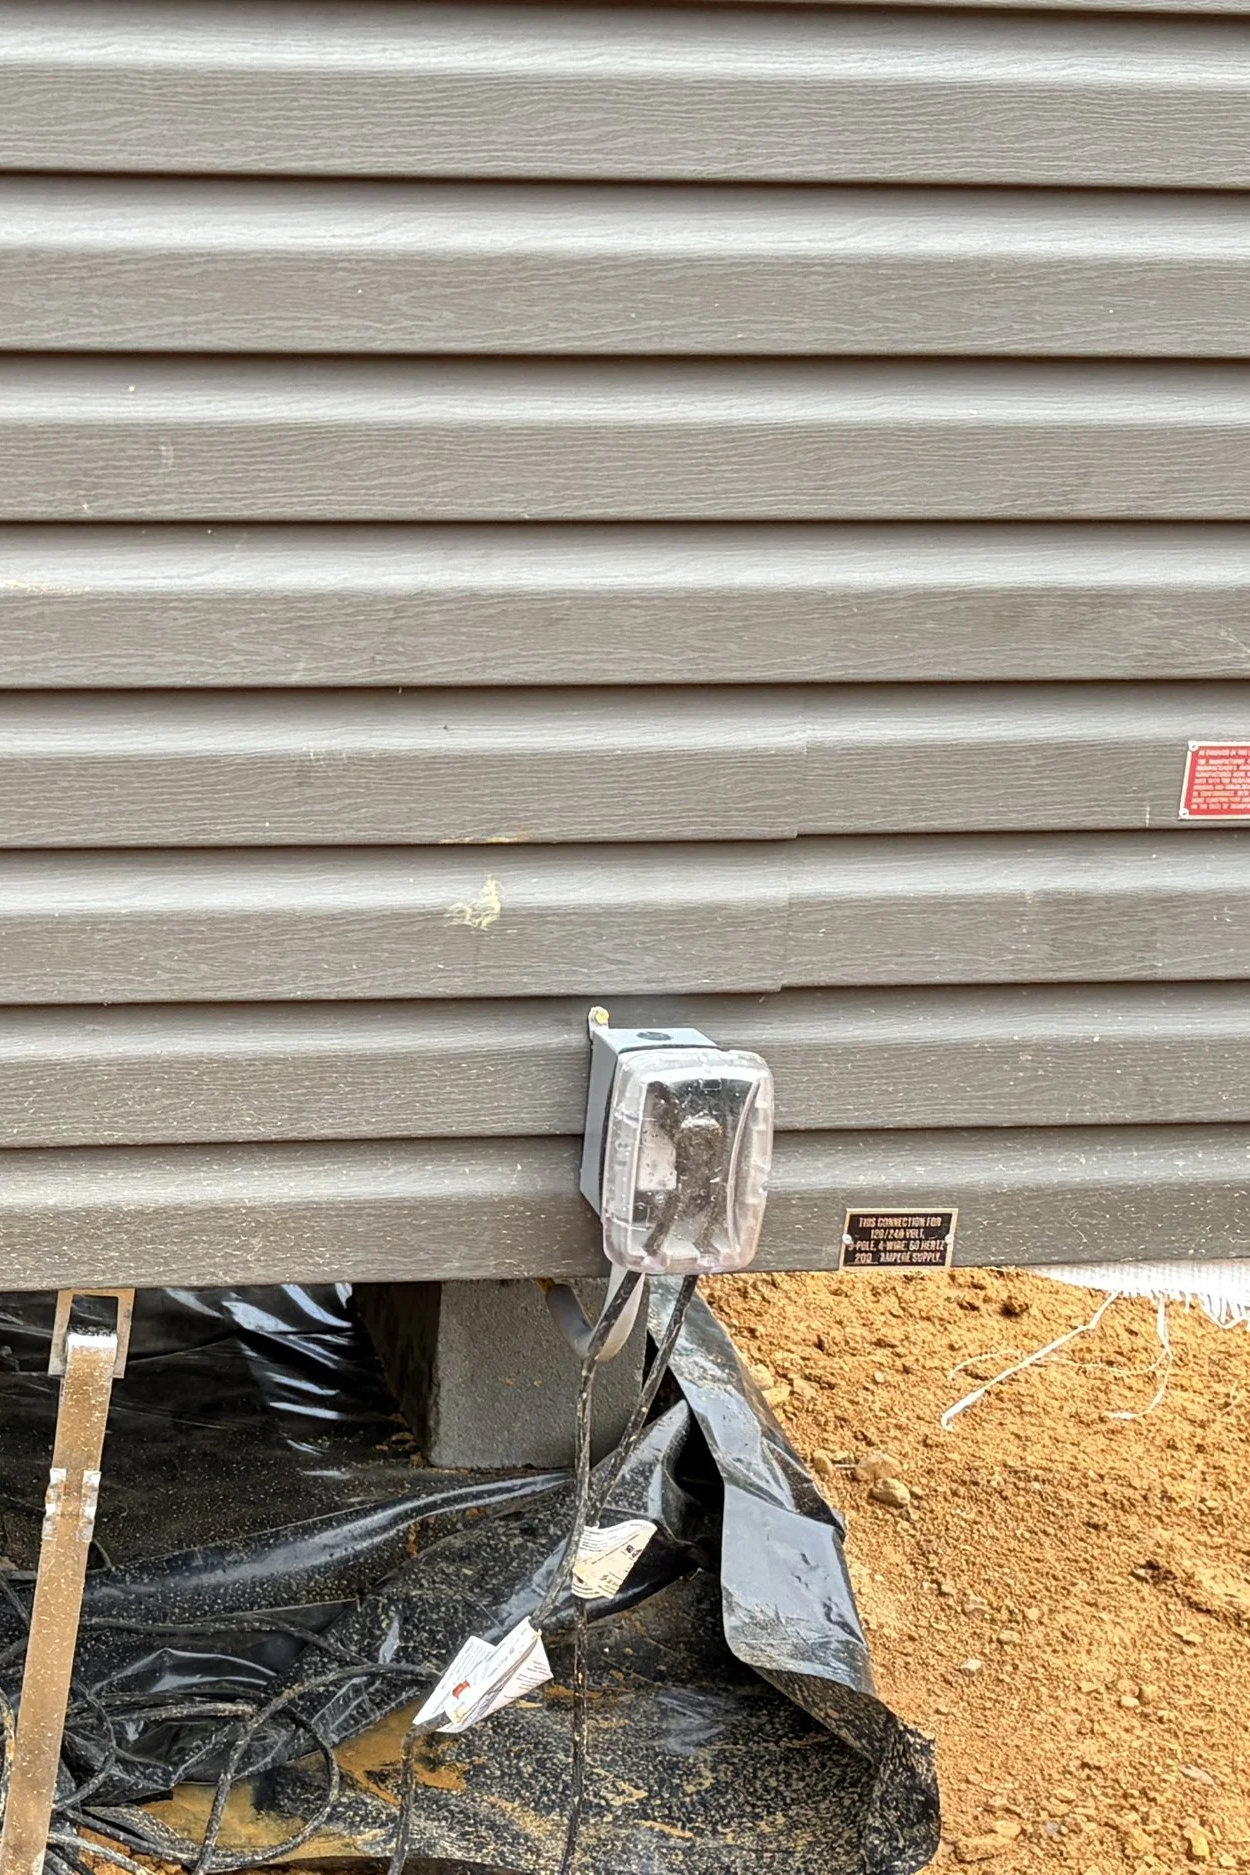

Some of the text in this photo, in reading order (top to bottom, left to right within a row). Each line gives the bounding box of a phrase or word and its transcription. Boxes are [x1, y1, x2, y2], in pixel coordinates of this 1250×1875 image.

[859, 1217, 942, 1228] THIS CONNECTION FOR
[870, 1229, 905, 1239] 120/240
[909, 1240, 920, 1251] 60
[920, 1240, 945, 1251] HERTZ
[880, 1252, 911, 1263] AMPERE
